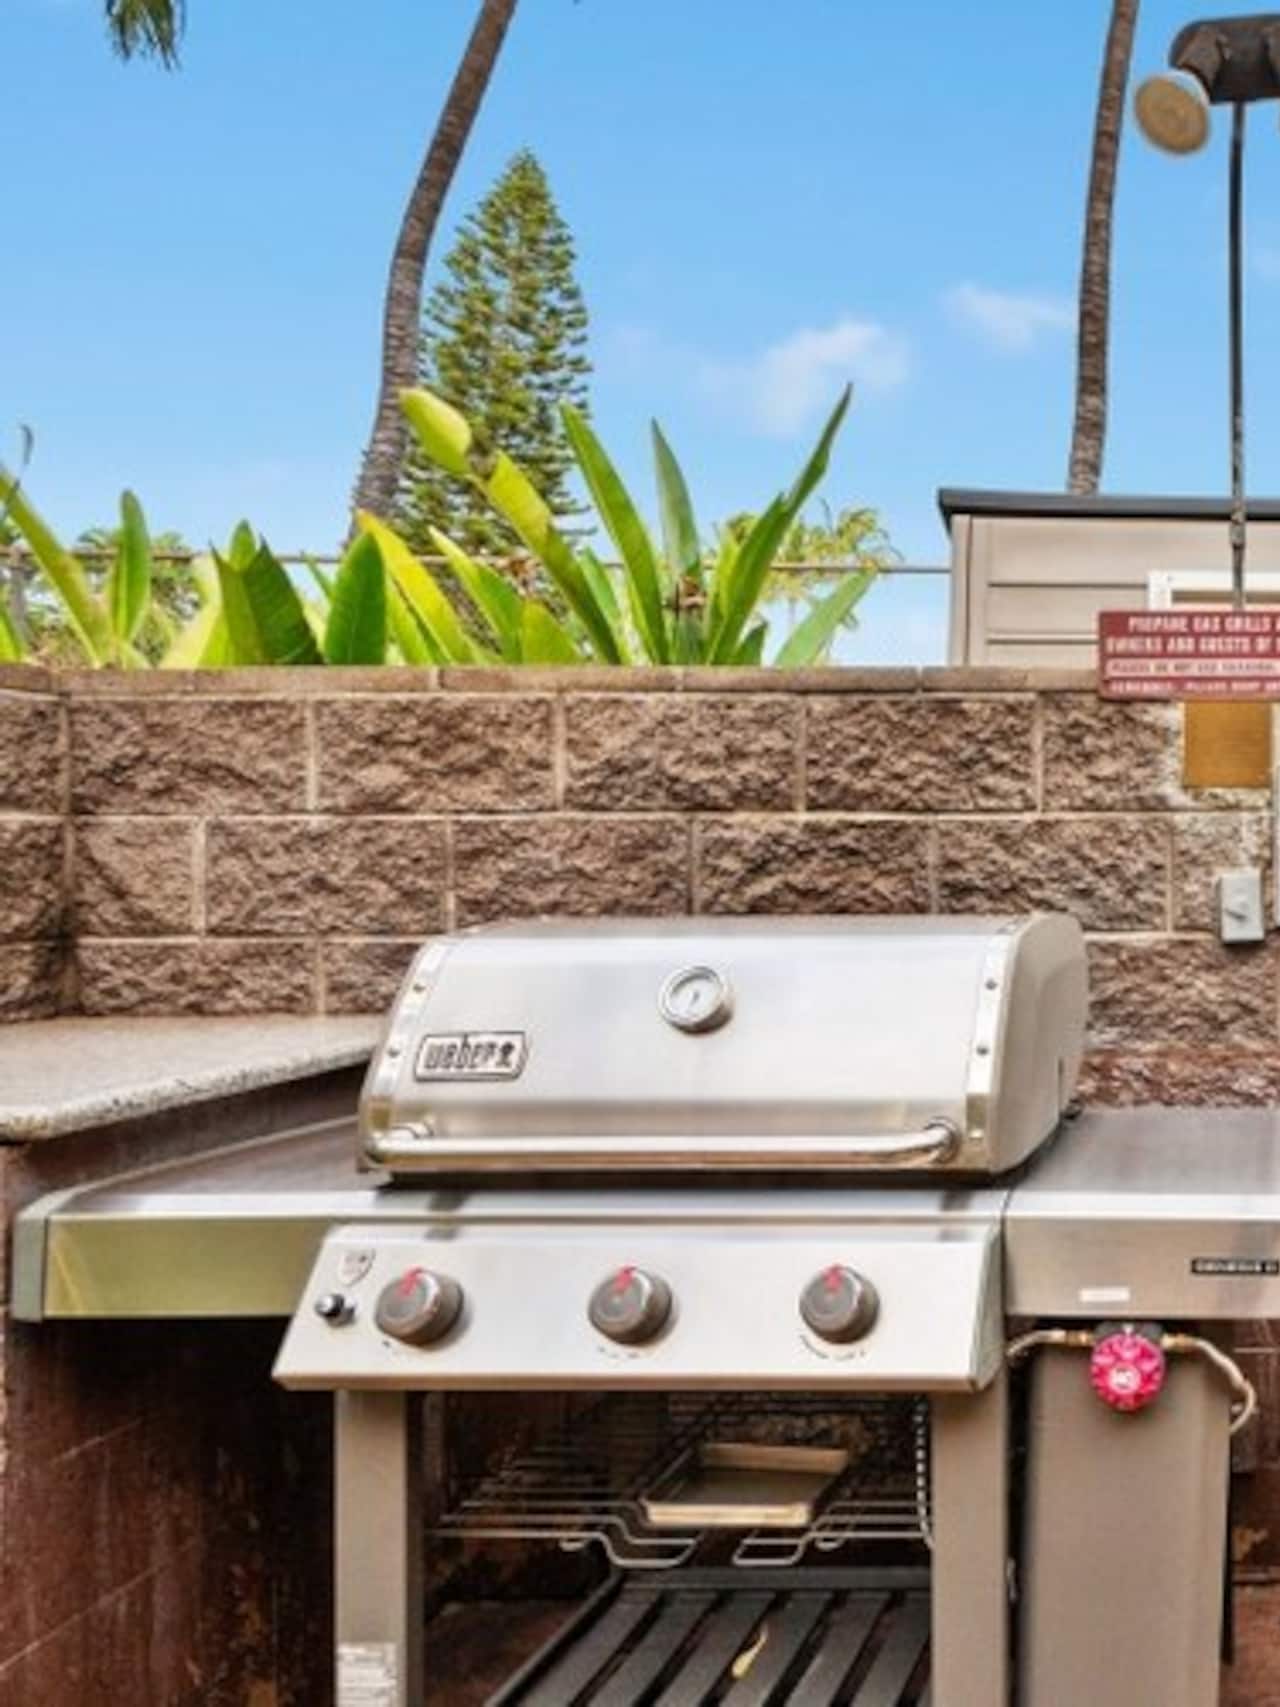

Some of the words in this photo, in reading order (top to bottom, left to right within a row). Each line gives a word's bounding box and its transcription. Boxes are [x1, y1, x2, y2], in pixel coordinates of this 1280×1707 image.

[1193, 615, 1220, 633] GAS
[1225, 615, 1270, 633] GRILLS
[1166, 636, 1195, 654] AND
[1254, 636, 1271, 654] OF
[425, 1034, 497, 1069] weber
